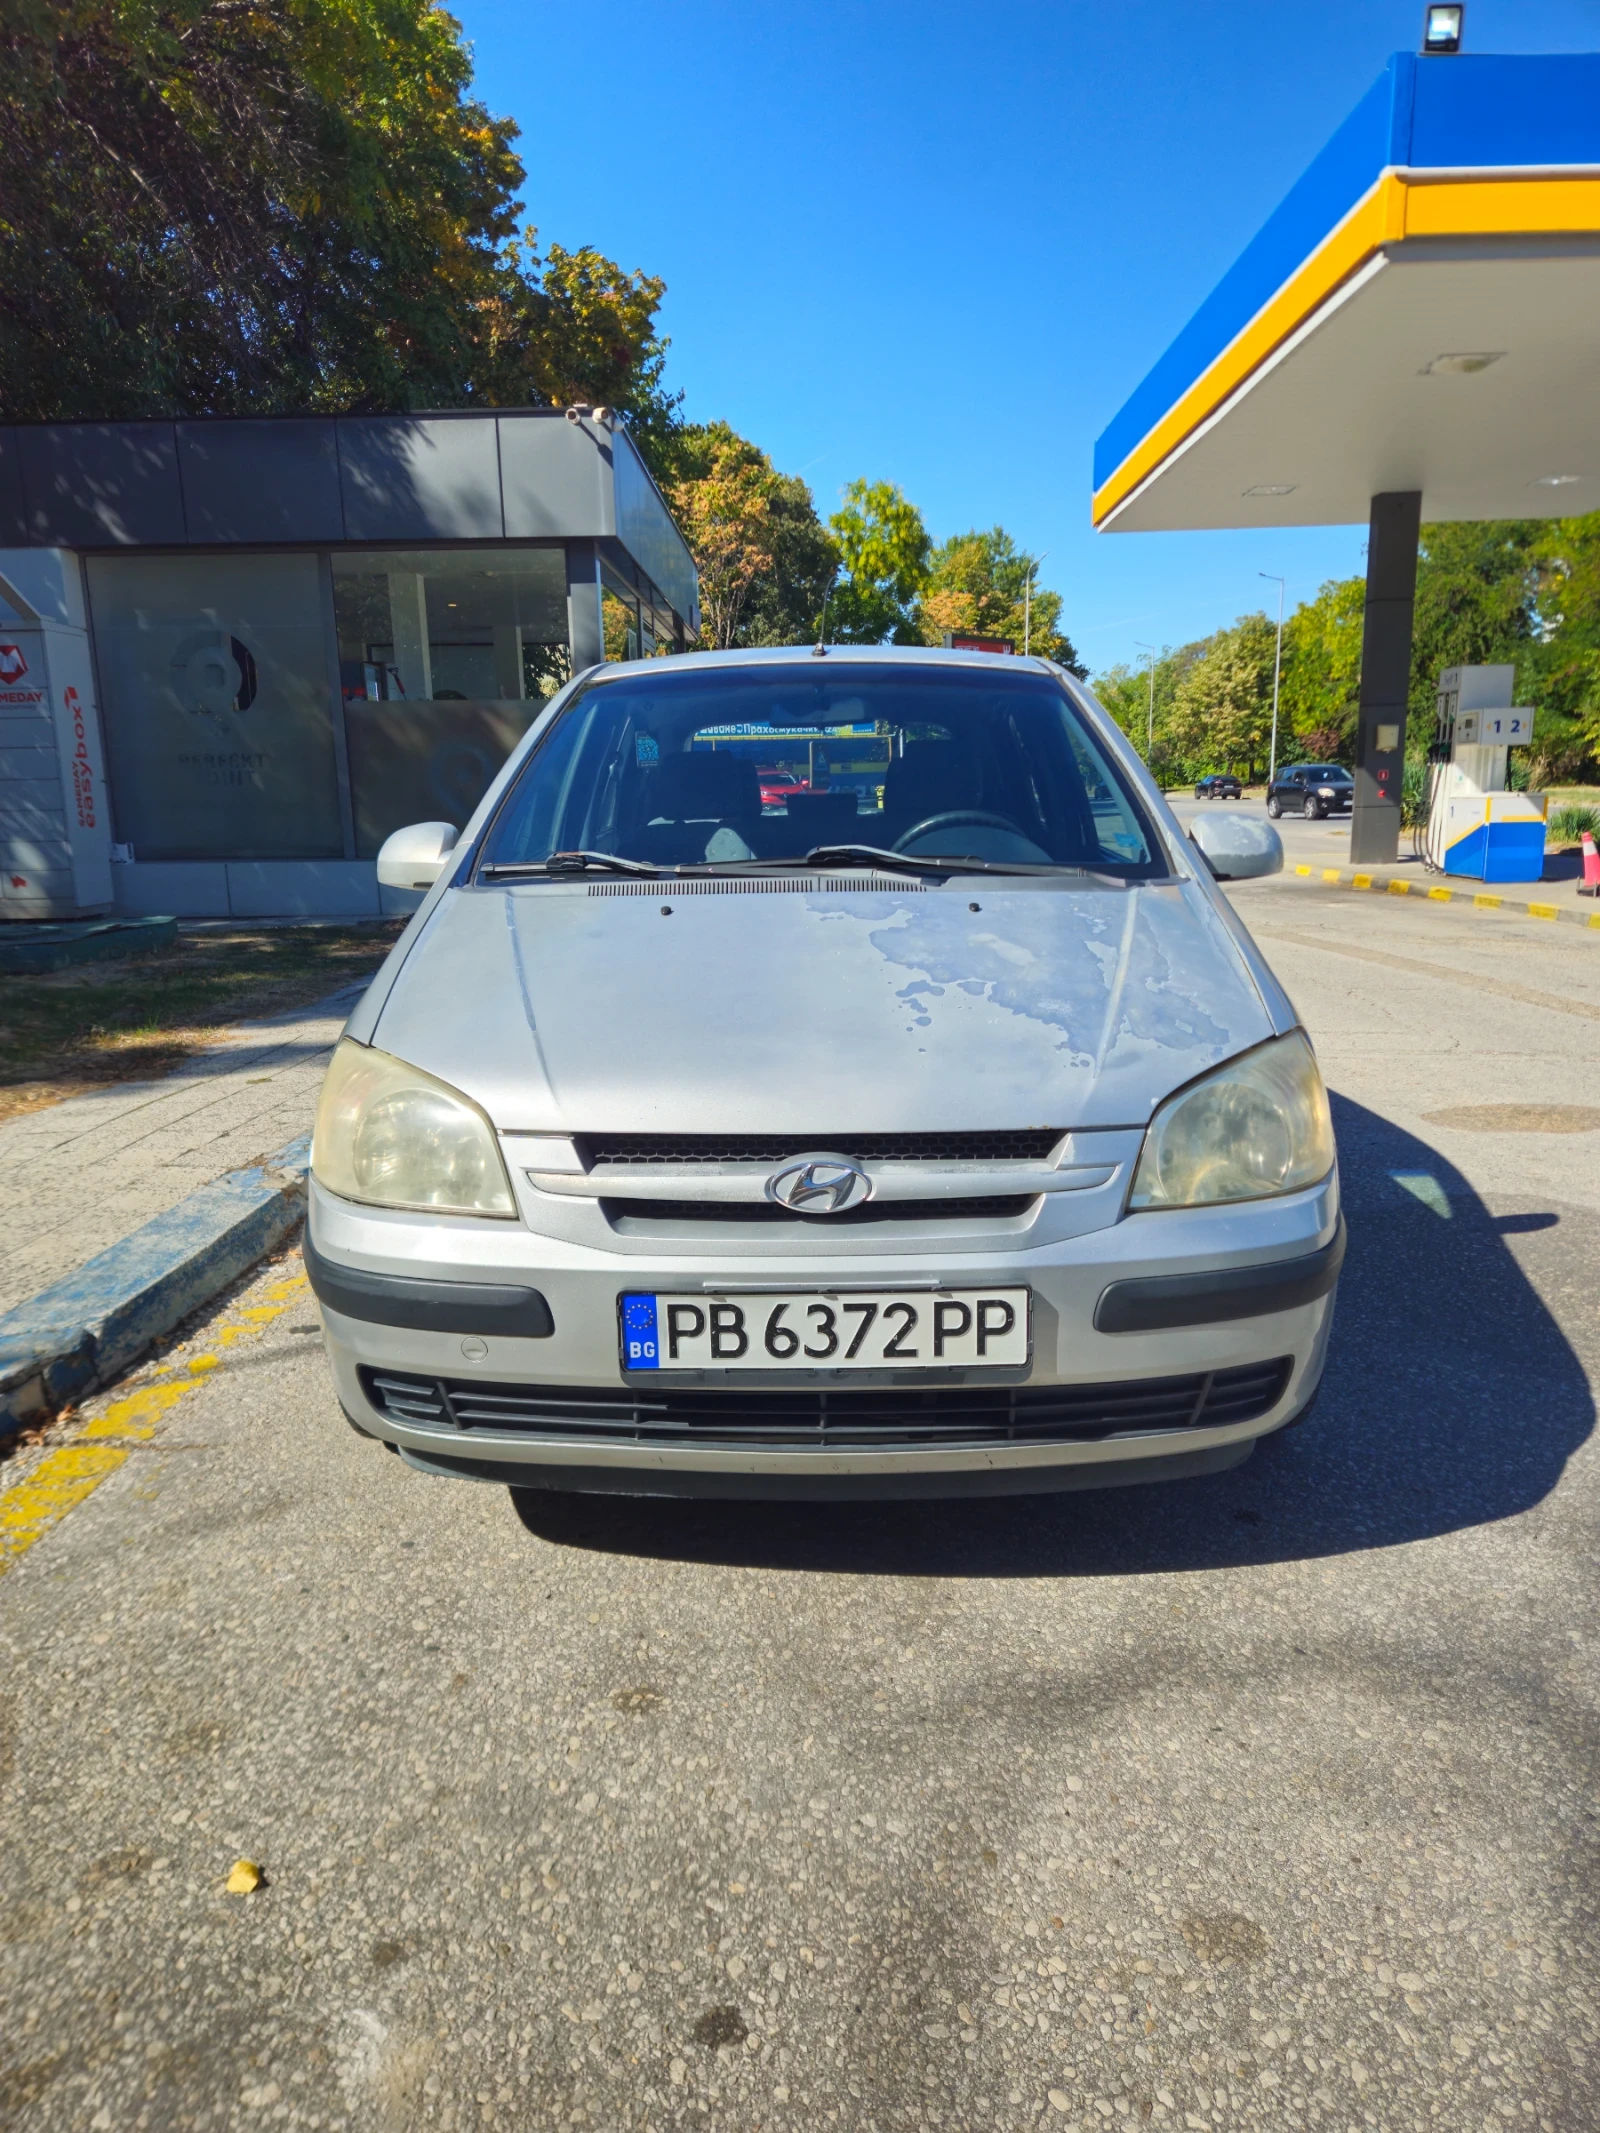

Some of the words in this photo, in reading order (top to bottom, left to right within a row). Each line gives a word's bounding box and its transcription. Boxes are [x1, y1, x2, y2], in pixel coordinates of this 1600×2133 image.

[1494, 720, 1502, 734] 1
[1510, 719, 1521, 734] 2
[71, 761, 86, 827] SAMEDAY
[72, 705, 96, 828] easybox
[629, 1341, 656, 1359] BG
[666, 1301, 749, 1360] PB
[763, 1302, 920, 1360] 6372
[932, 1299, 1016, 1358] PP
